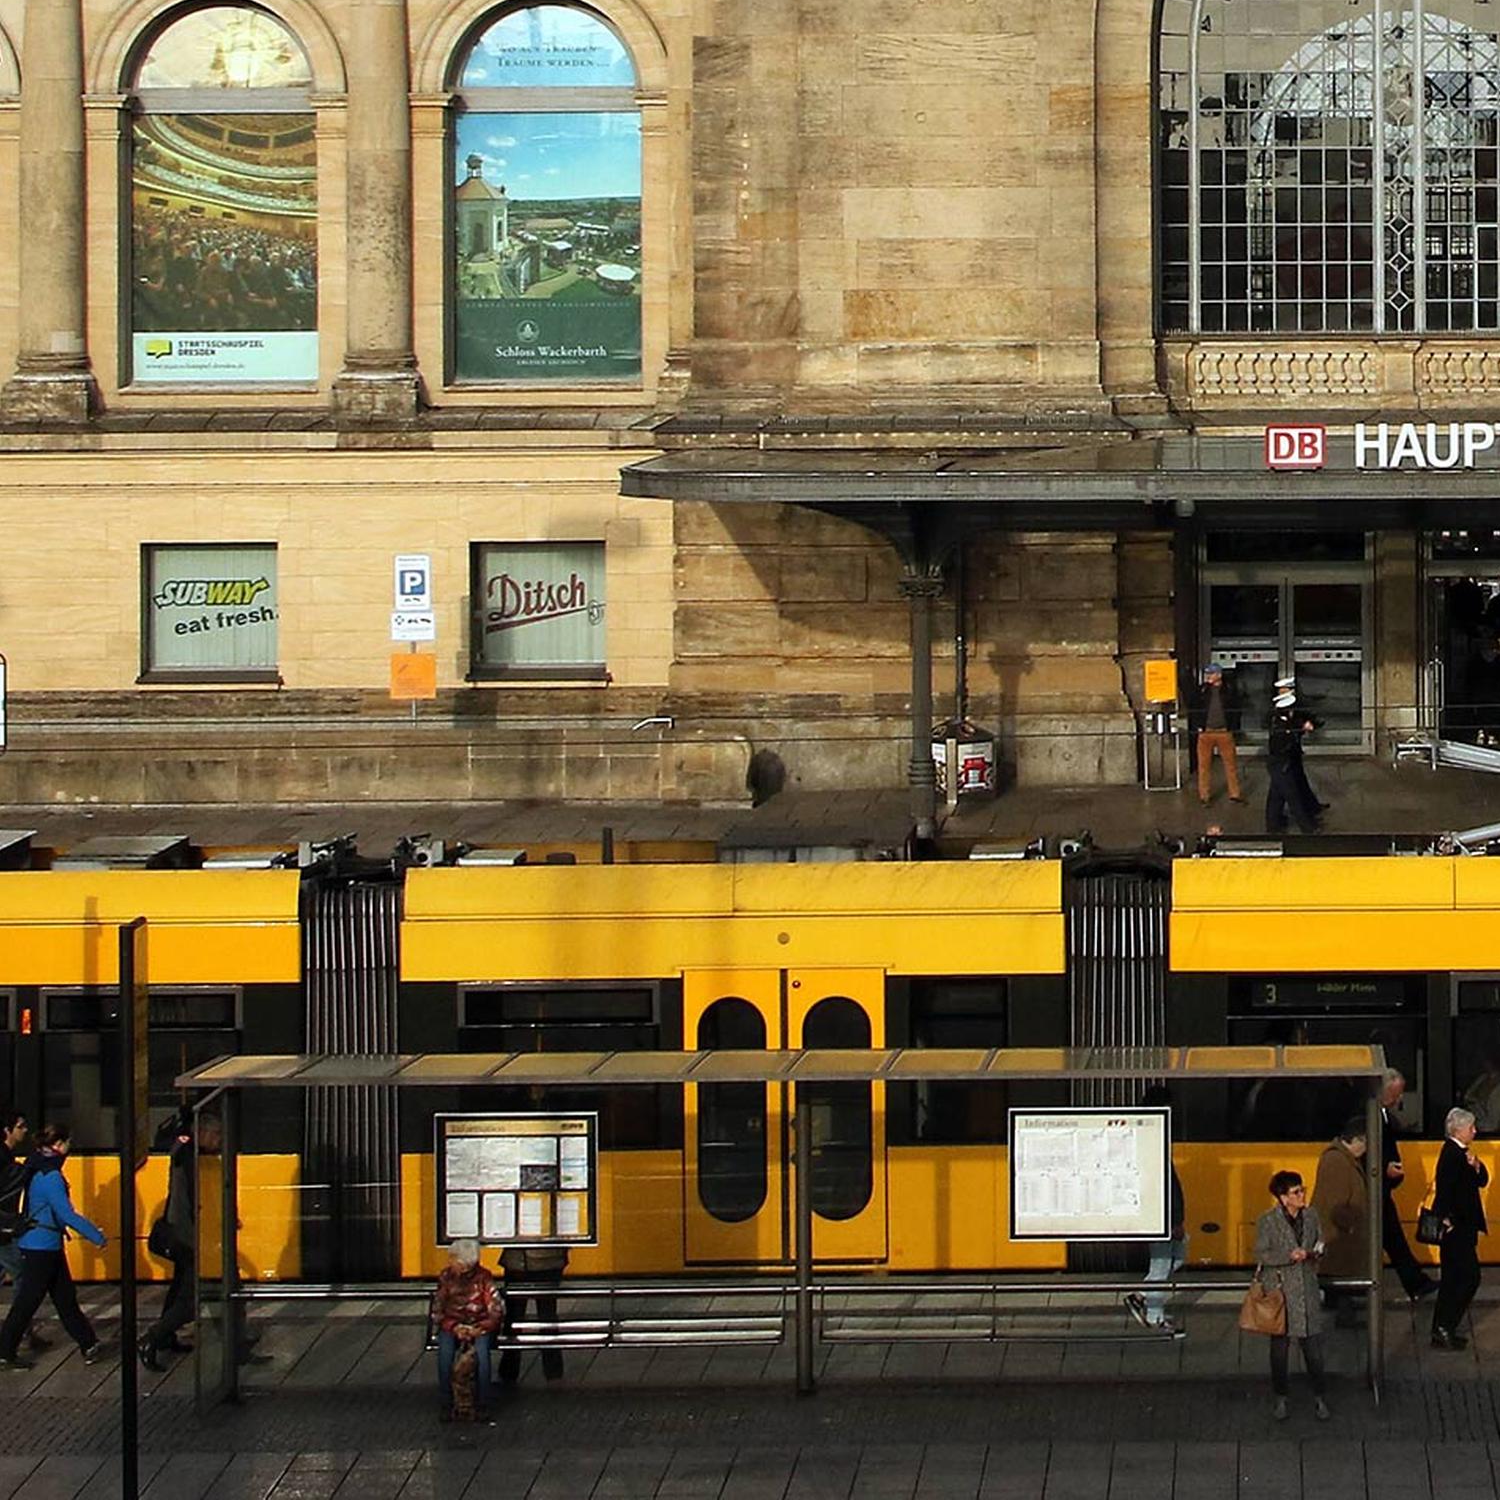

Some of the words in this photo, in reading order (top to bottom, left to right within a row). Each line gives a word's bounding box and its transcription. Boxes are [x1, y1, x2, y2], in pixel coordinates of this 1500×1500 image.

[495, 346, 536, 357] Schloss
[537, 345, 607, 357] Wackerbarth
[1272, 430, 1320, 459] DB
[153, 577, 270, 609] SUBWAY
[404, 571, 423, 594] P
[488, 573, 586, 621] Ditsch
[175, 616, 210, 635] eat
[1265, 983, 1277, 1004] 3
